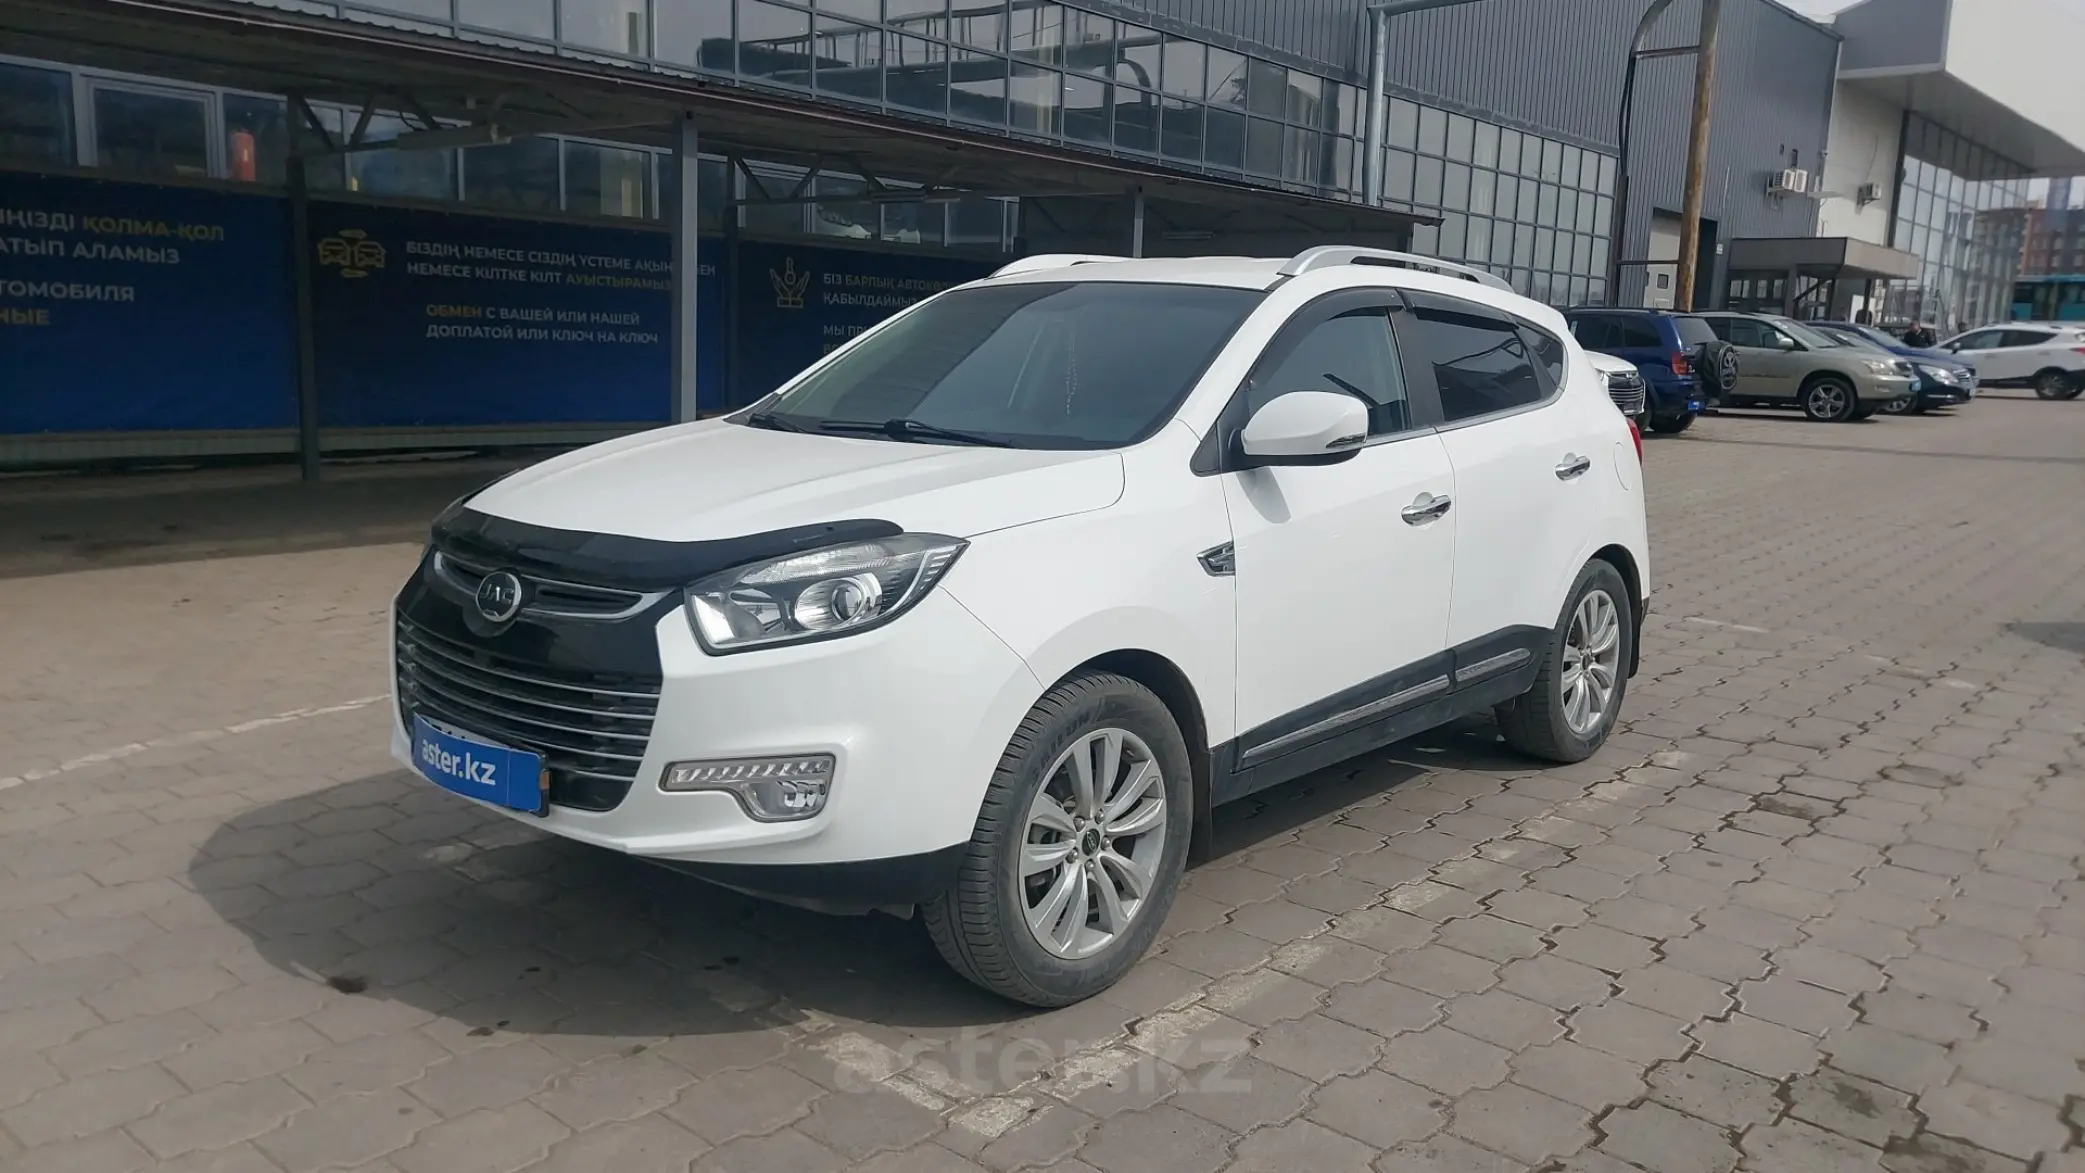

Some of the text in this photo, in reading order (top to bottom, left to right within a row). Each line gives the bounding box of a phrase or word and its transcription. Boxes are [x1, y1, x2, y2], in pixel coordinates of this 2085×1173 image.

[83, 215, 225, 243] ҚОЛМА-ҚОЛ
[72, 241, 181, 265] АЛАМЫЗ
[406, 241, 461, 260] БІЗДІҢ
[464, 245, 525, 263] НЕМЕСЕ
[528, 251, 577, 268] СІЗДІҢ
[407, 262, 471, 279] НЕМЕСЕ
[475, 266, 527, 282] КІЛТКЕ
[530, 271, 562, 284] КІЛТ
[823, 273, 842, 286] БІЗ
[845, 274, 897, 291] БАРЛЫҚ
[426, 304, 640, 326] ОБМЕН С ВАШЕЙ ИЛИ НАШЕЙ
[426, 324, 659, 345] ДОПЛАТОЙ ИЛИ КЛЮЧ НА КЛЮЧ
[823, 323, 845, 337] МЫ
[421, 738, 496, 786] aster.kz
